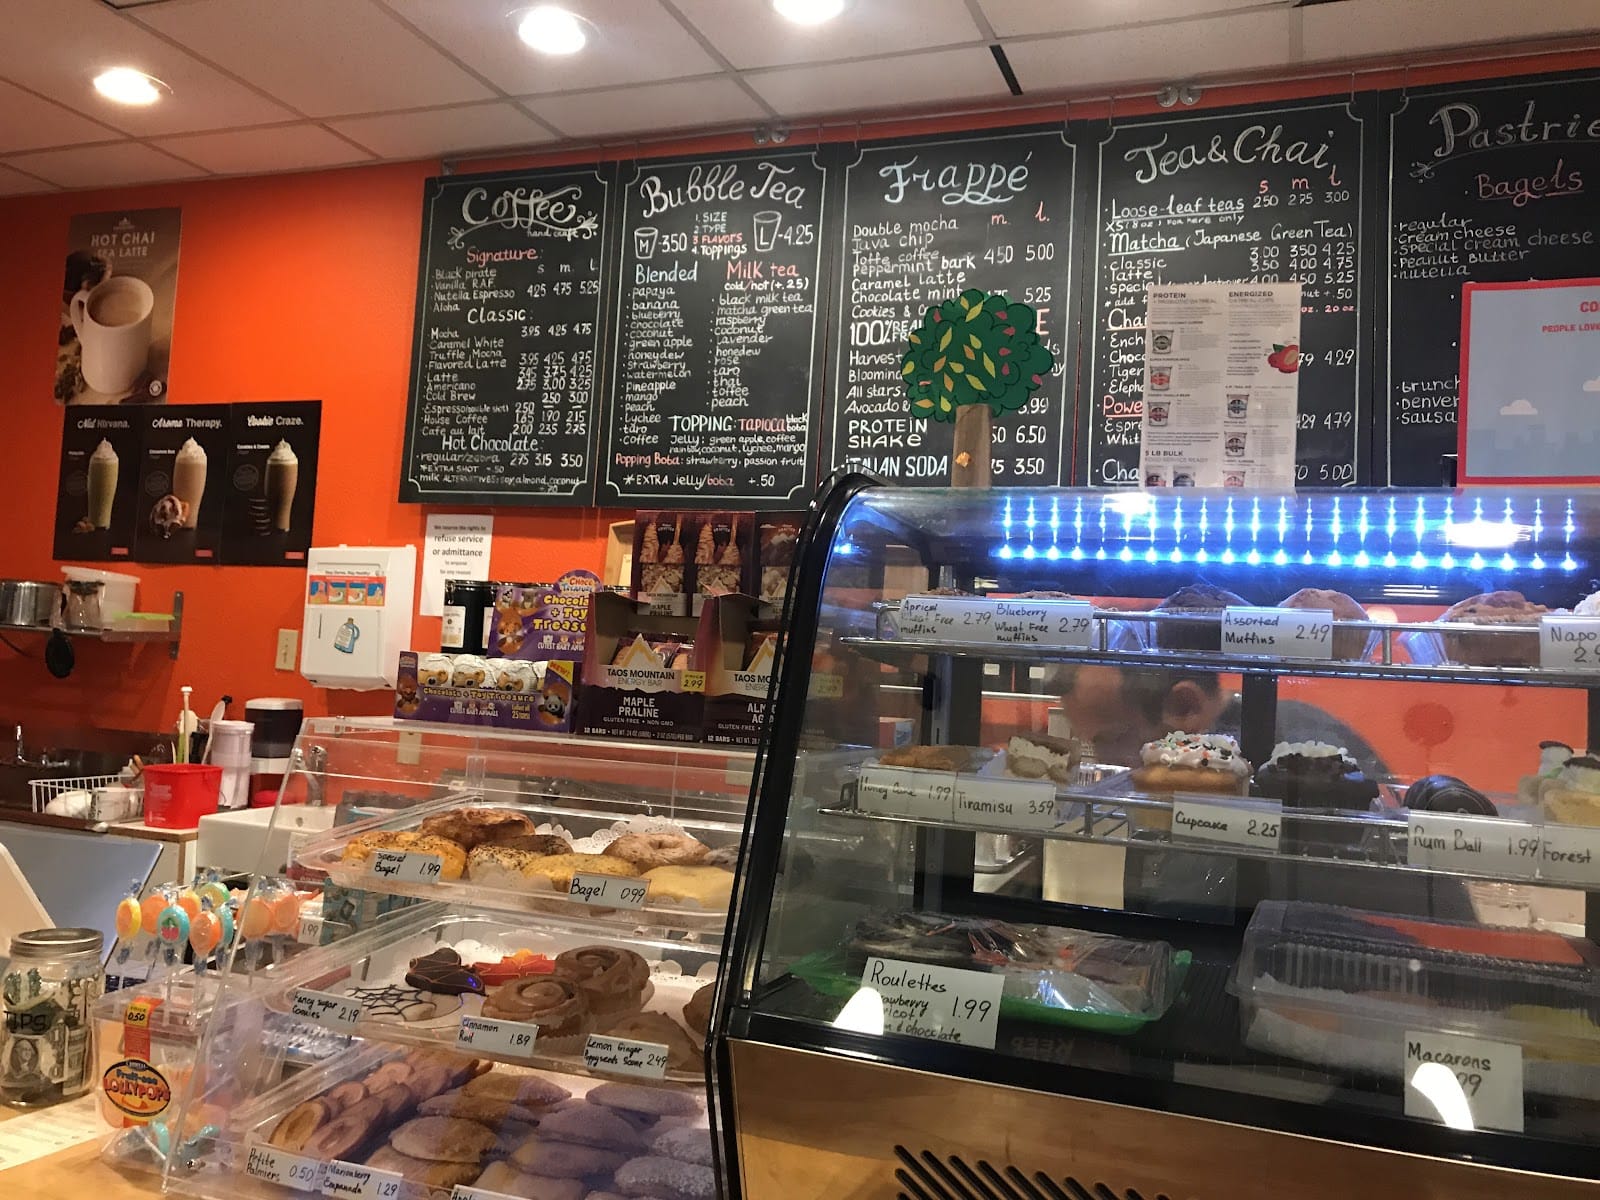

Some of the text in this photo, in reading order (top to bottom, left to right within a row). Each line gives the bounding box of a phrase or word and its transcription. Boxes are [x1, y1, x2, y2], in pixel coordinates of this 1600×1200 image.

[1475, 159, 1584, 207] Bagels
[640, 162, 806, 219] Bubble Tea
[462, 186, 582, 230] Coffee
[1208, 197, 1246, 214] teas
[702, 211, 728, 223] SIZE
[1400, 212, 1473, 232] regular
[702, 224, 727, 234] TYPE
[853, 213, 959, 238] Double mocha
[91, 231, 156, 248] HOT CHAI
[899, 232, 935, 250] chip
[1108, 222, 1314, 252] Matcha Green
[1399, 225, 1516, 245] cream cheese
[1464, 237, 1520, 251] cream
[1528, 229, 1594, 247] cheese
[119, 247, 149, 258] LATTE
[898, 248, 940, 263] coffee
[941, 251, 977, 271] bark
[1109, 257, 1168, 272] classic
[635, 260, 698, 285] Blended
[726, 260, 800, 280] Milk tea
[1111, 269, 1154, 283] latte
[1399, 264, 1471, 280] nutella
[852, 275, 911, 291] Caramel
[473, 289, 515, 303] Espresso
[632, 287, 675, 300] papaya
[719, 290, 802, 306] black milk tea
[852, 285, 963, 305] Chocolate mint
[1228, 290, 1274, 298] ENERGIZED
[632, 300, 680, 311] banana
[717, 303, 814, 316] matcha green tea
[851, 304, 896, 320] Cookies
[630, 317, 684, 329] chocolate
[631, 311, 681, 322] blueberry
[715, 314, 766, 328] raspberry
[1107, 309, 1147, 330] Chai
[629, 327, 674, 340] coconut
[714, 326, 764, 338] coconut
[850, 320, 893, 346] 100%
[1542, 324, 1576, 333] PEOPLE
[474, 336, 504, 348] White
[663, 336, 693, 349] apple
[628, 349, 685, 362] honeydew
[714, 356, 740, 365] rose
[428, 358, 473, 371] Flavored
[627, 359, 686, 372] strawberry
[713, 366, 740, 377] taro
[626, 369, 692, 380] watermelon
[426, 381, 476, 392] Americano
[626, 380, 677, 394] pineapple
[713, 376, 742, 388] thai
[425, 391, 476, 402] Cold Brew
[625, 391, 658, 404] mango
[712, 386, 750, 397] toffee
[846, 385, 864, 400] All
[624, 401, 655, 413] peach
[711, 395, 749, 412] peach
[845, 400, 900, 415] Avocado
[456, 414, 488, 424] Coffee
[623, 423, 648, 434] taro
[442, 435, 466, 451] Hot
[623, 434, 659, 445] coffee
[765, 432, 796, 443] coffee
[776, 442, 805, 454] mango
[615, 452, 651, 468] Popping
[744, 457, 778, 470] passion
[780, 456, 804, 467] fruit
[905, 455, 949, 478] SODA
[434, 534, 484, 544] refuse service
[441, 548, 483, 557] admittance
[563, 607, 588, 620] Toy
[996, 603, 1048, 622] Blueberry
[995, 621, 1024, 633] Wheat
[1028, 623, 1049, 633] Free
[1224, 613, 1280, 628] Assorted
[997, 632, 1038, 643] muffins
[1225, 623, 1331, 646] Muffins 2.49
[607, 668, 675, 680] TAOS MOUNTAIN
[734, 673, 757, 683] TAOS
[617, 679, 663, 687] ENERGY BAR
[623, 696, 655, 708] MAPLE
[618, 706, 659, 719] PRALINE
[958, 790, 1013, 814] Tiramisu
[1247, 819, 1280, 839] 2.25
[1413, 825, 1446, 851] Rum
[1454, 828, 1482, 854] Ball
[1542, 840, 1592, 865] Forest
[374, 862, 400, 877] Bagel
[570, 879, 606, 902] Bagel
[870, 960, 993, 1023] Roulettes 1.99
[587, 1036, 643, 1057] Lemon Ginger
[1407, 1041, 1492, 1071] Macarons
[249, 1148, 277, 1168] Petite
